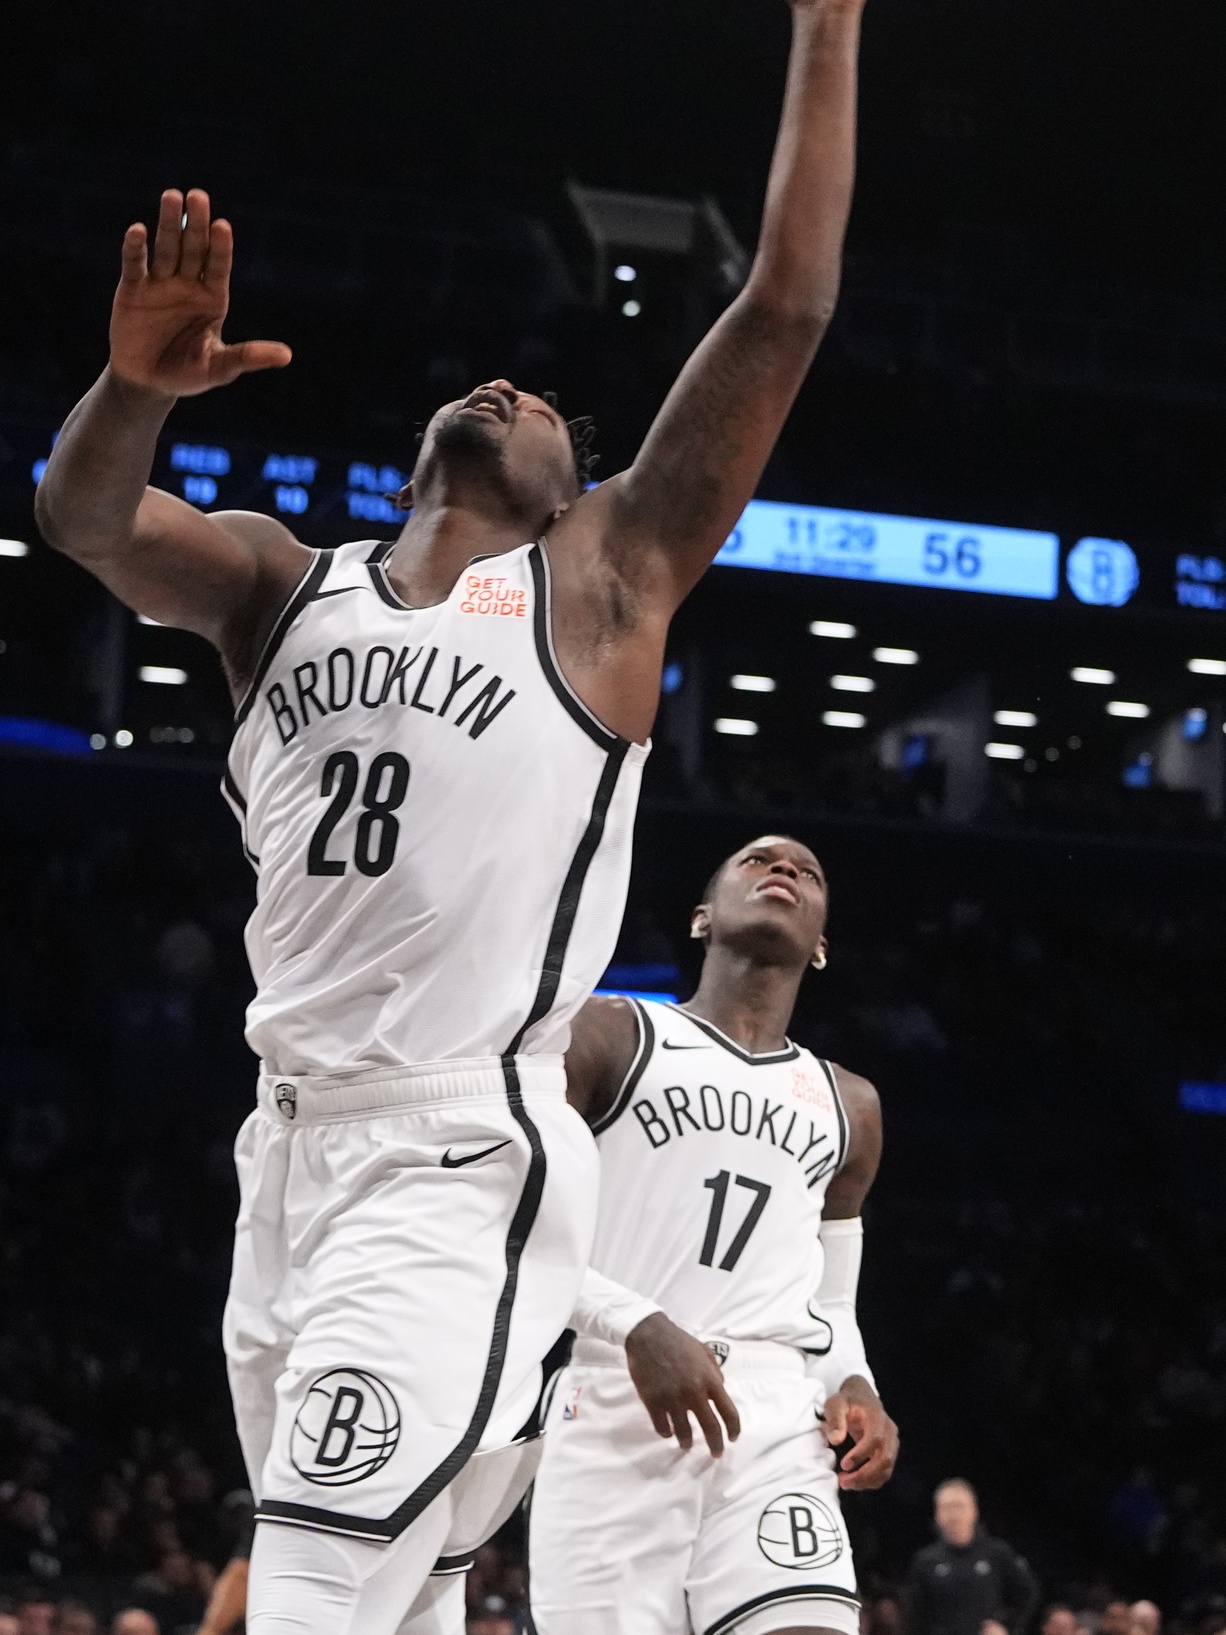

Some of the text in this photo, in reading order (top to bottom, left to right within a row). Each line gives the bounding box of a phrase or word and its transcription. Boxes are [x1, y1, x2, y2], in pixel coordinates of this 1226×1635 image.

[467, 575, 507, 589] GET
[922, 531, 982, 578] 56
[460, 601, 527, 617] GUIDE
[466, 588, 525, 602] YOUR
[266, 646, 517, 747] BROOKLYN
[307, 750, 411, 877] 28
[632, 1085, 839, 1189] BROOKLYN
[699, 1169, 772, 1272] 17
[315, 1386, 365, 1467] B
[790, 1506, 819, 1557] B
